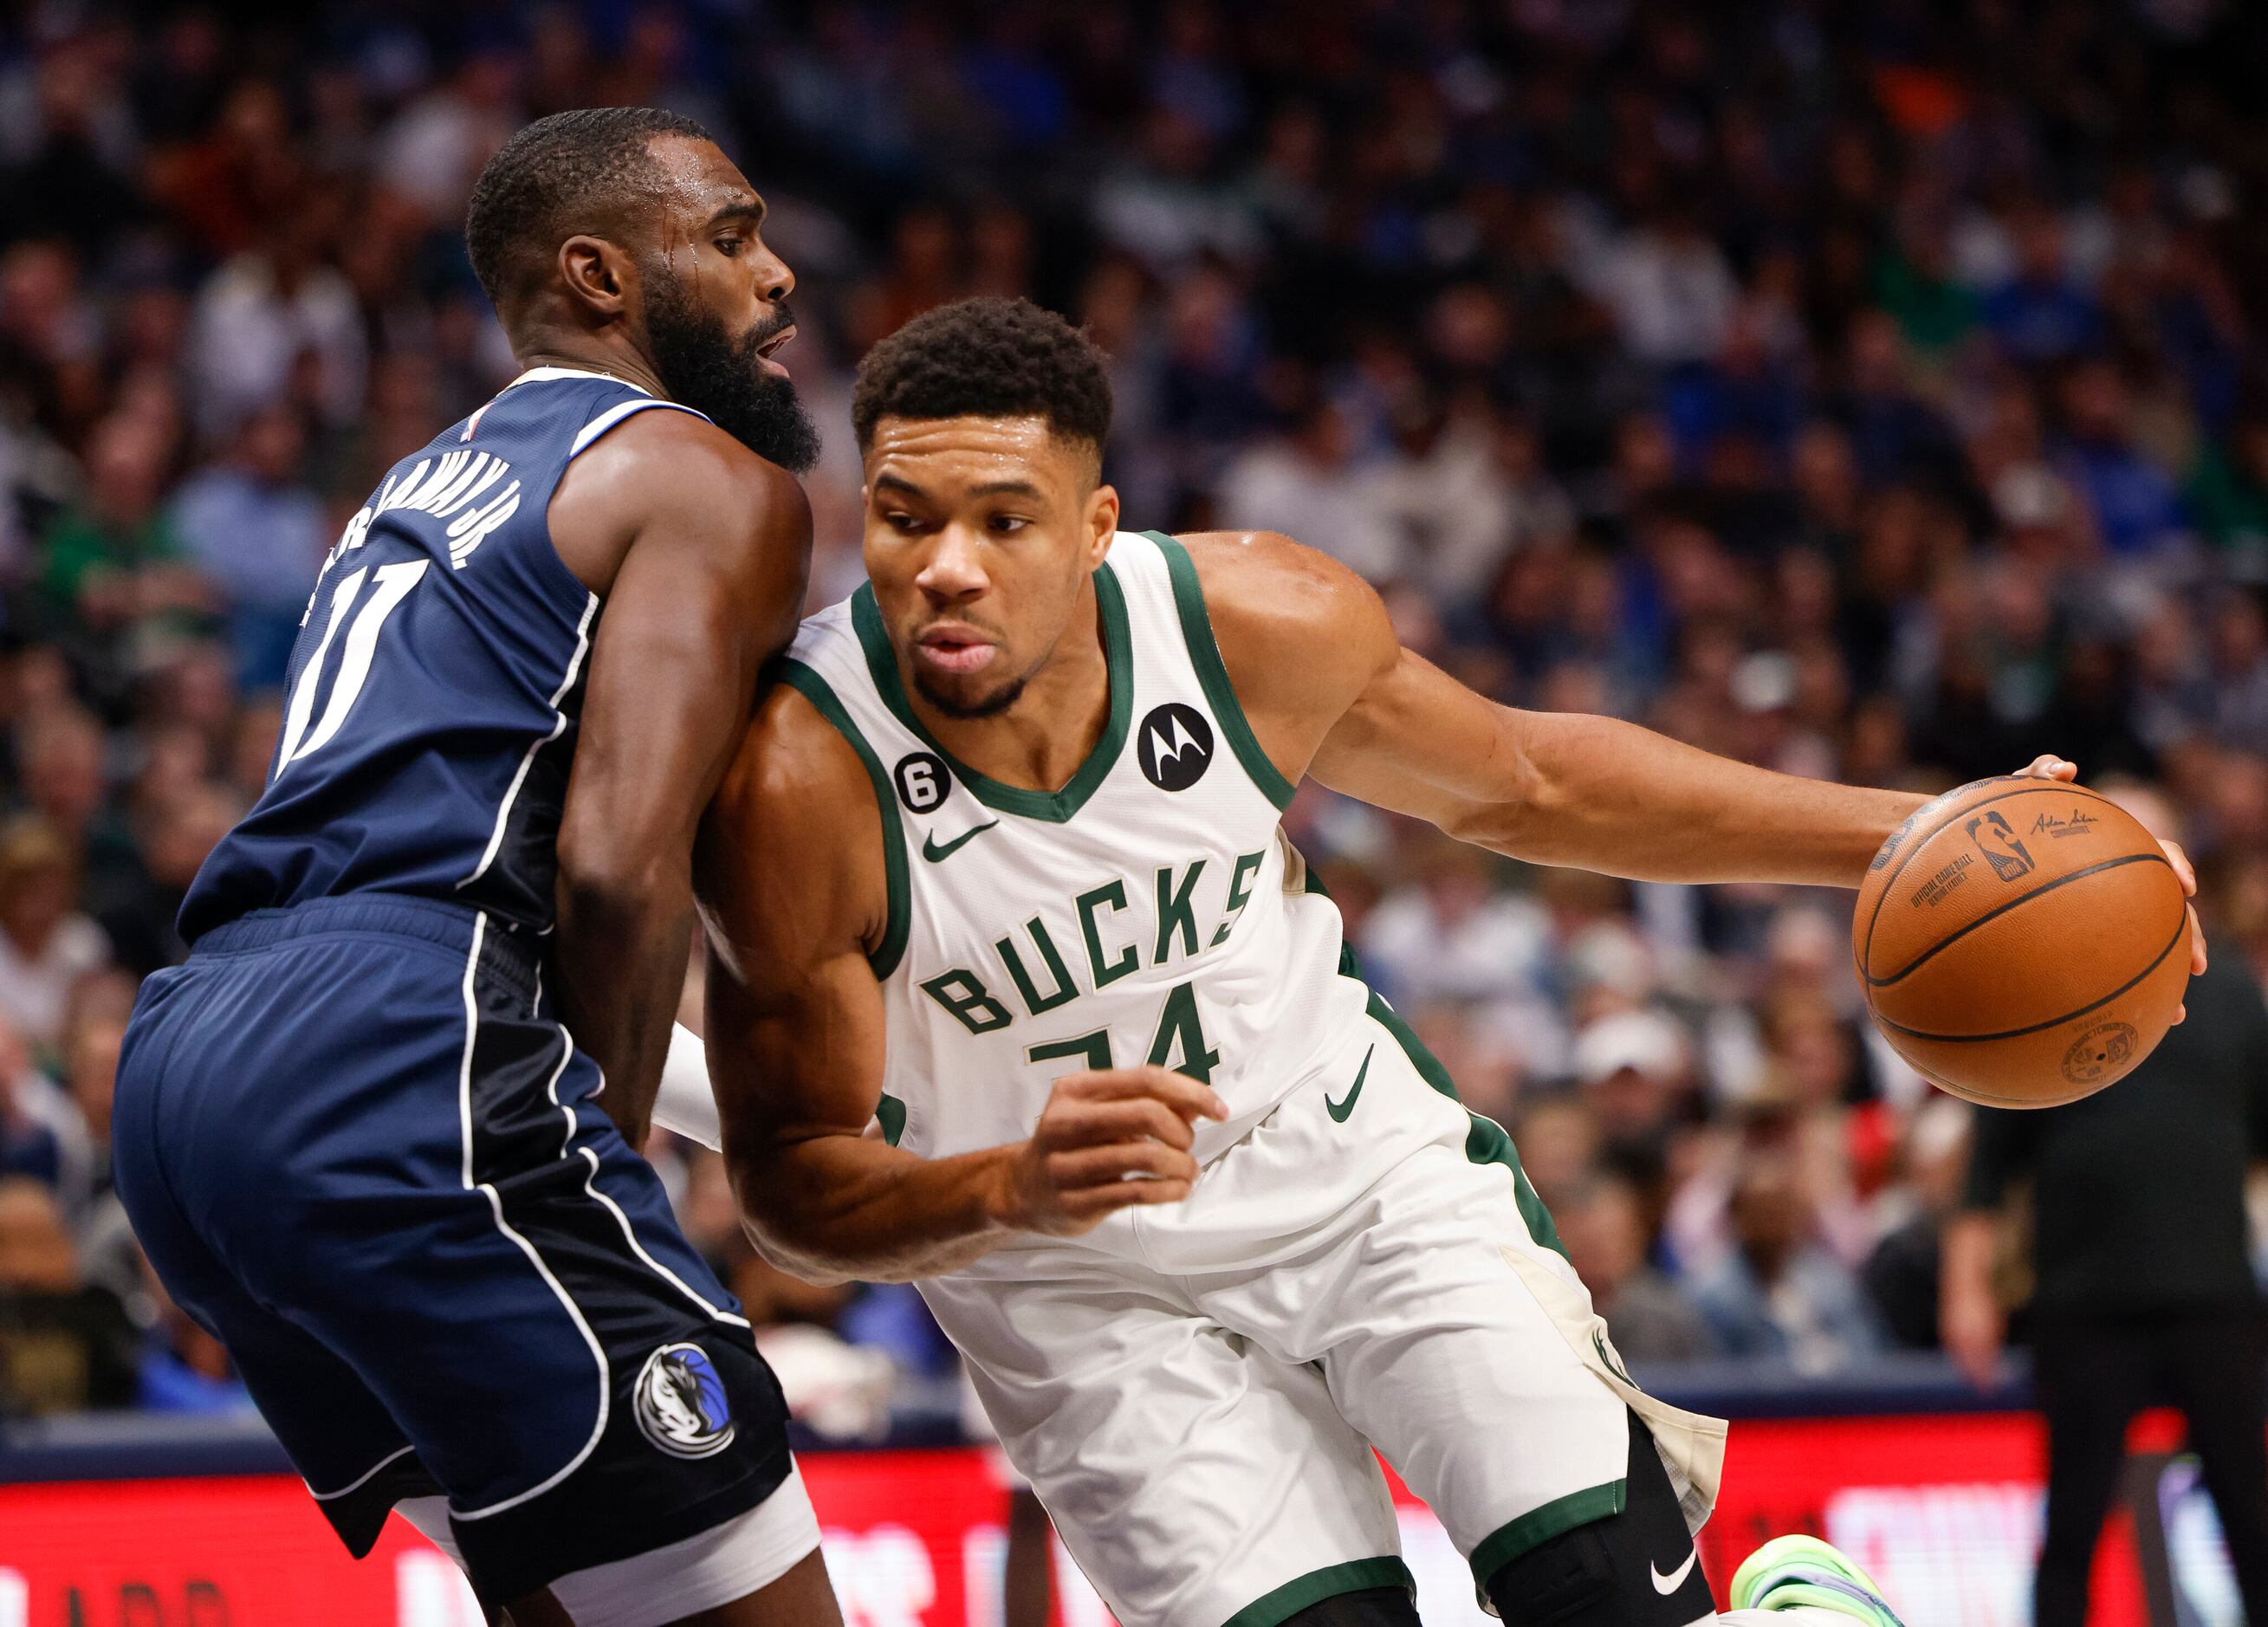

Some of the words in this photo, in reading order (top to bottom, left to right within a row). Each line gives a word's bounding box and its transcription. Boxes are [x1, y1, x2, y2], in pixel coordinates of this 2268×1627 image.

[903, 762, 939, 807] 6
[1911, 879, 1939, 909] OFFICIAL
[1935, 863, 1957, 885] GAME
[1954, 853, 1974, 871] BALL
[915, 848, 1267, 1035] BUCKS
